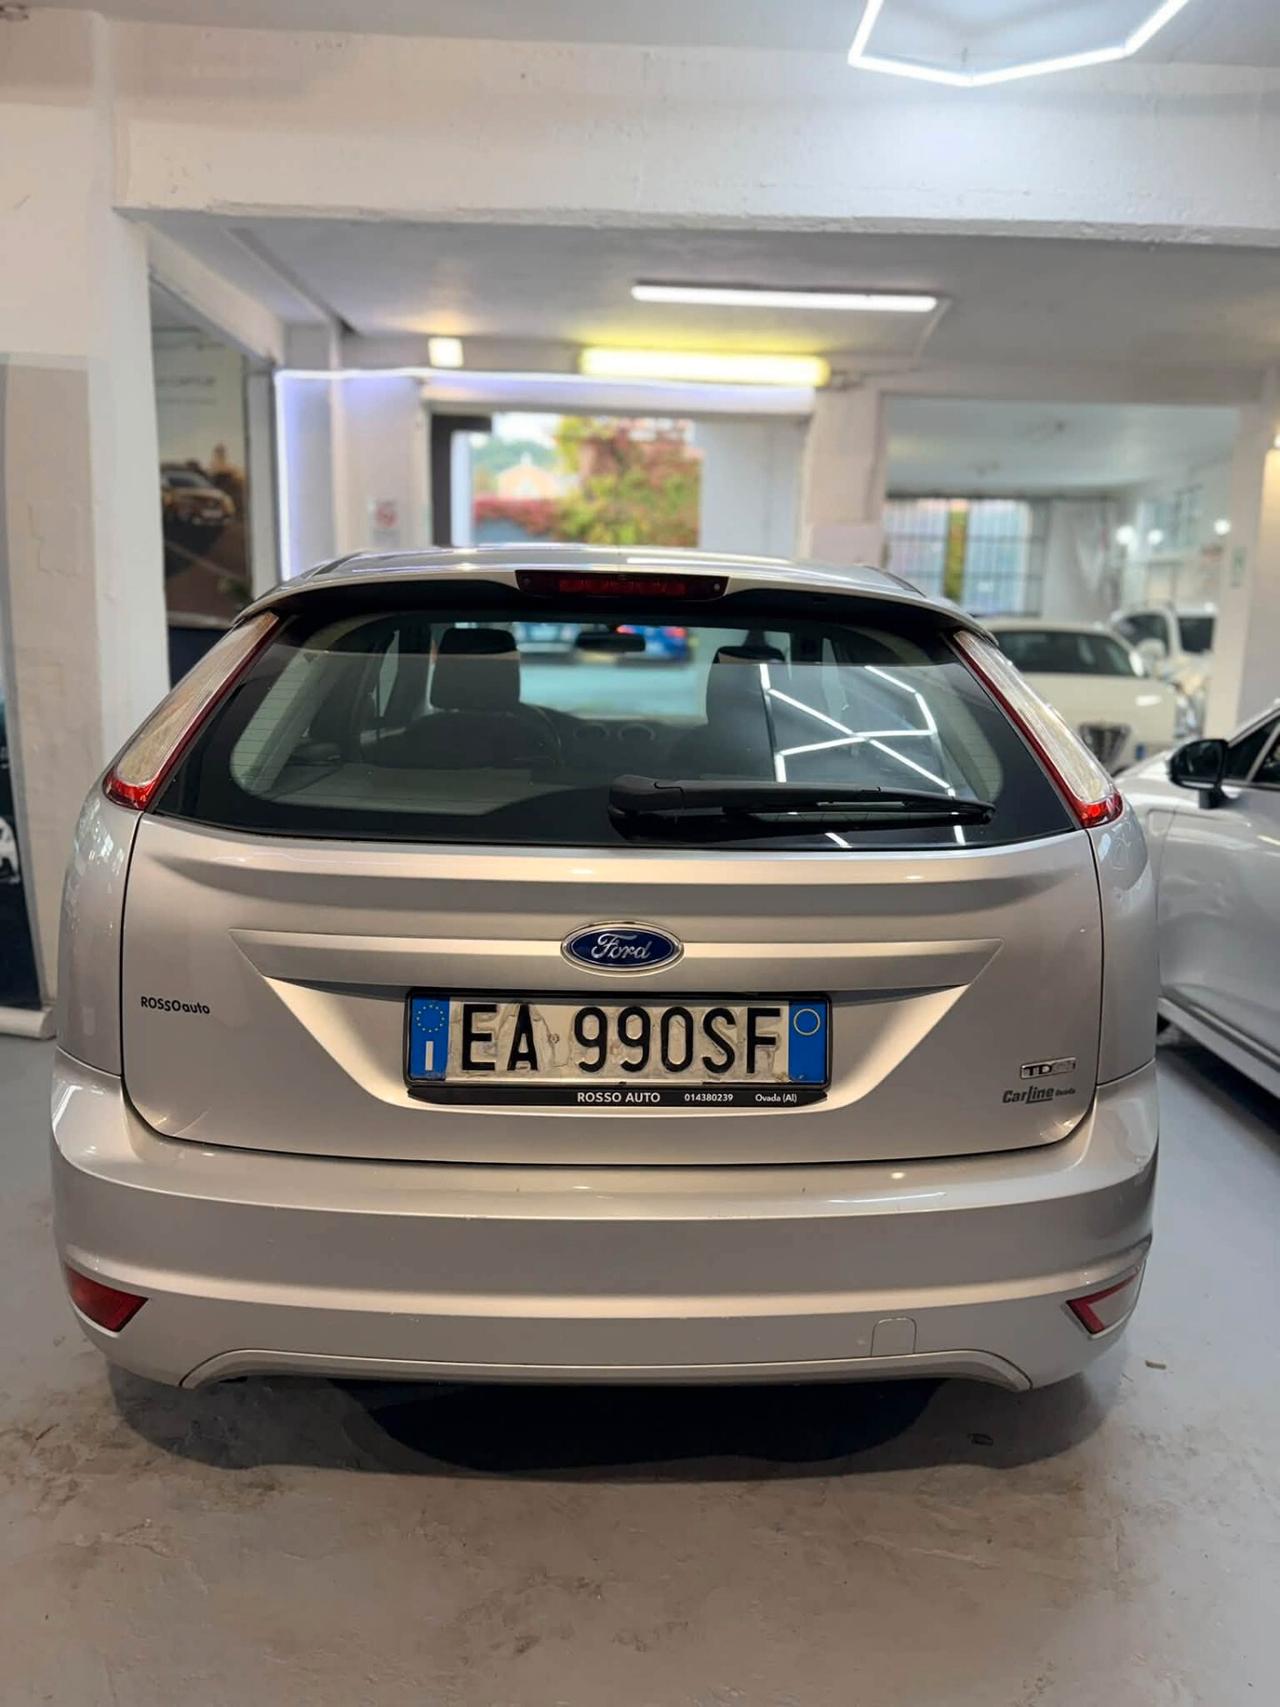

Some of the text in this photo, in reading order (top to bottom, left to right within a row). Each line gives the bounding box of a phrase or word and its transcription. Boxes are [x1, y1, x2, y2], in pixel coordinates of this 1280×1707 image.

[591, 933, 652, 959] Ford
[461, 1003, 782, 1074] EA 990SF
[577, 1092, 622, 1103] ROSSO
[625, 1092, 661, 1103] AUTO
[684, 1093, 734, 1102] 014380239
[755, 1093, 781, 1102] Ovada
